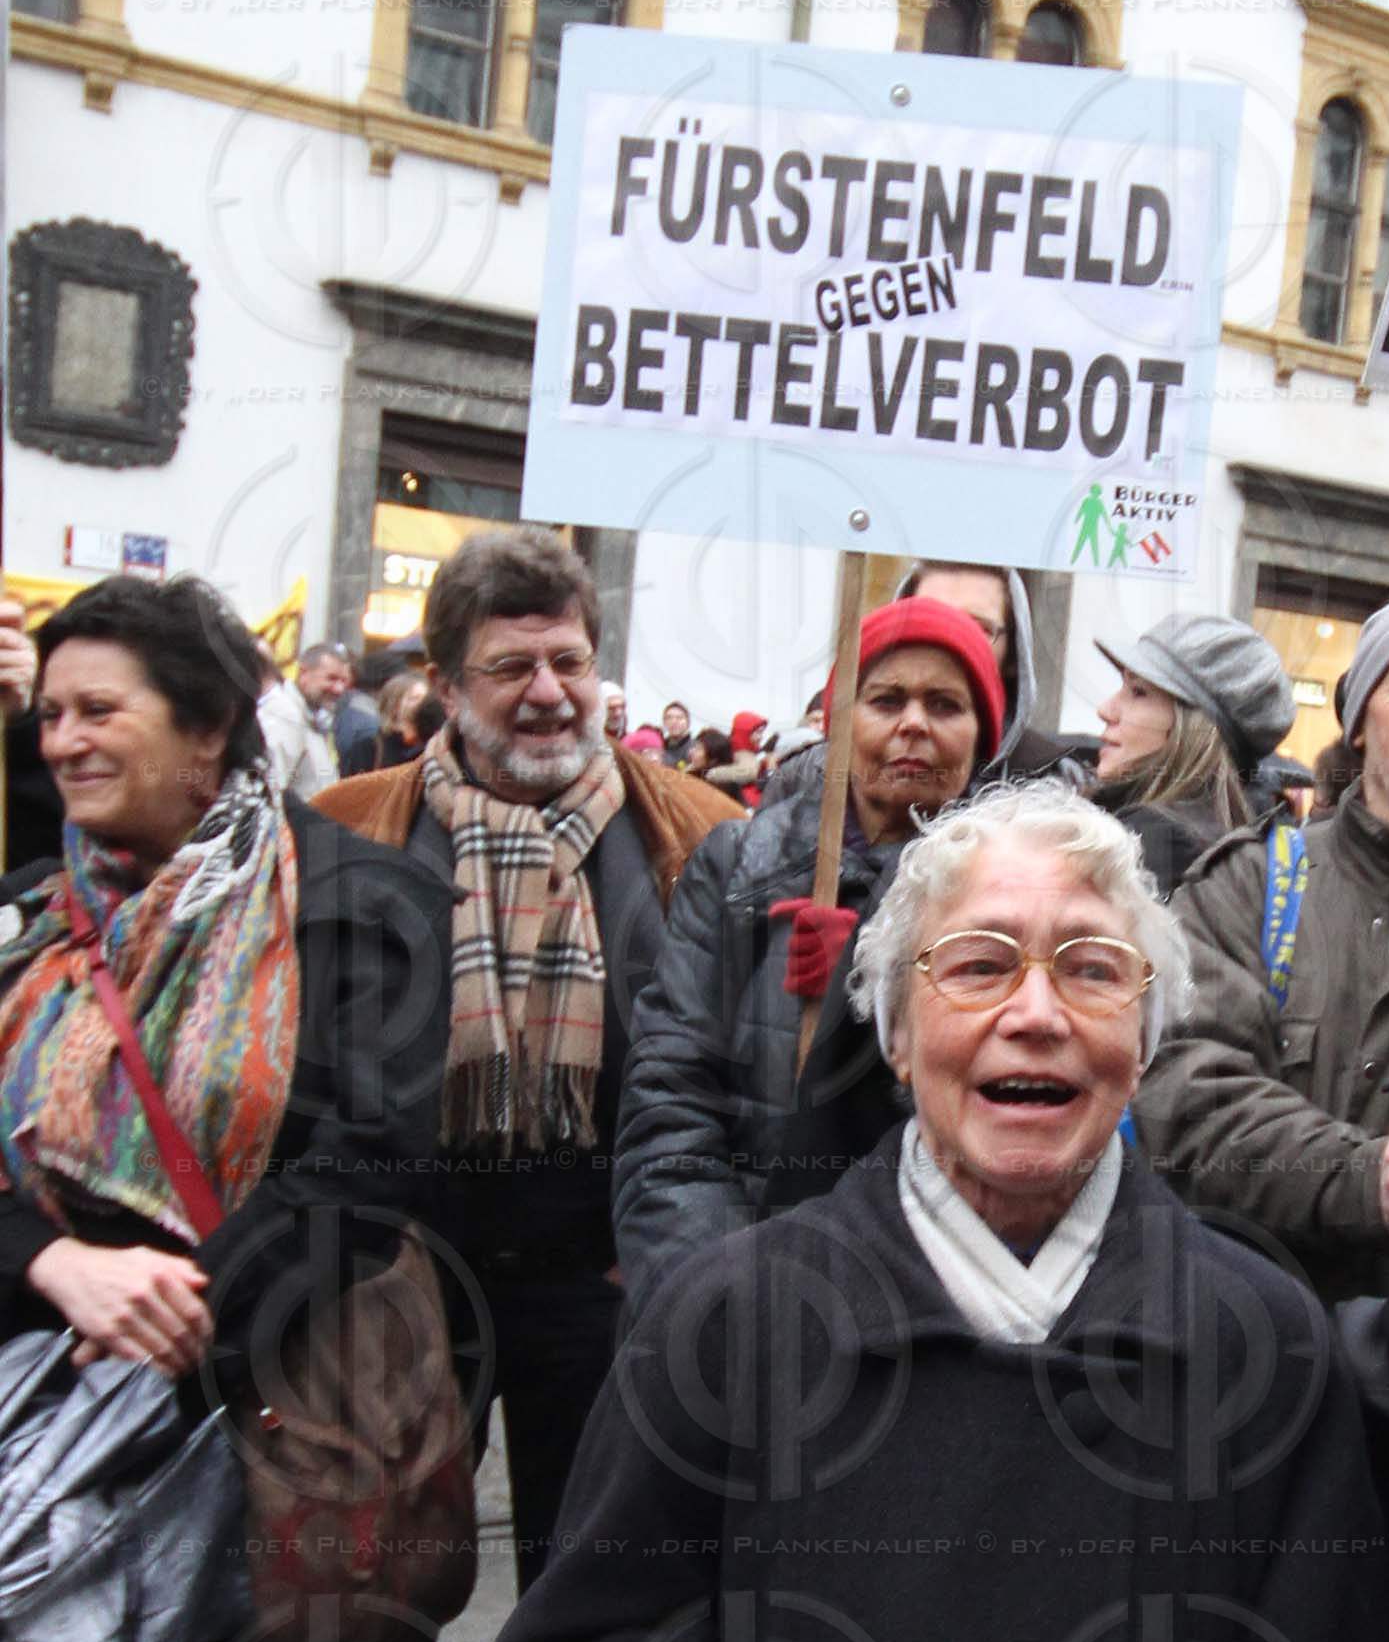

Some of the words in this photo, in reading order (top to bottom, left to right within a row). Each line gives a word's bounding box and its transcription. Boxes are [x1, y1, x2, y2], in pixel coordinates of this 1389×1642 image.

[611, 118, 1171, 286] FÜRSTENFELD
[815, 255, 957, 333] GEGEN
[570, 305, 1183, 462] BETTELVERBOT
[1111, 502, 1177, 522] AKTIV
[1114, 484, 1198, 507] BÜRGER
